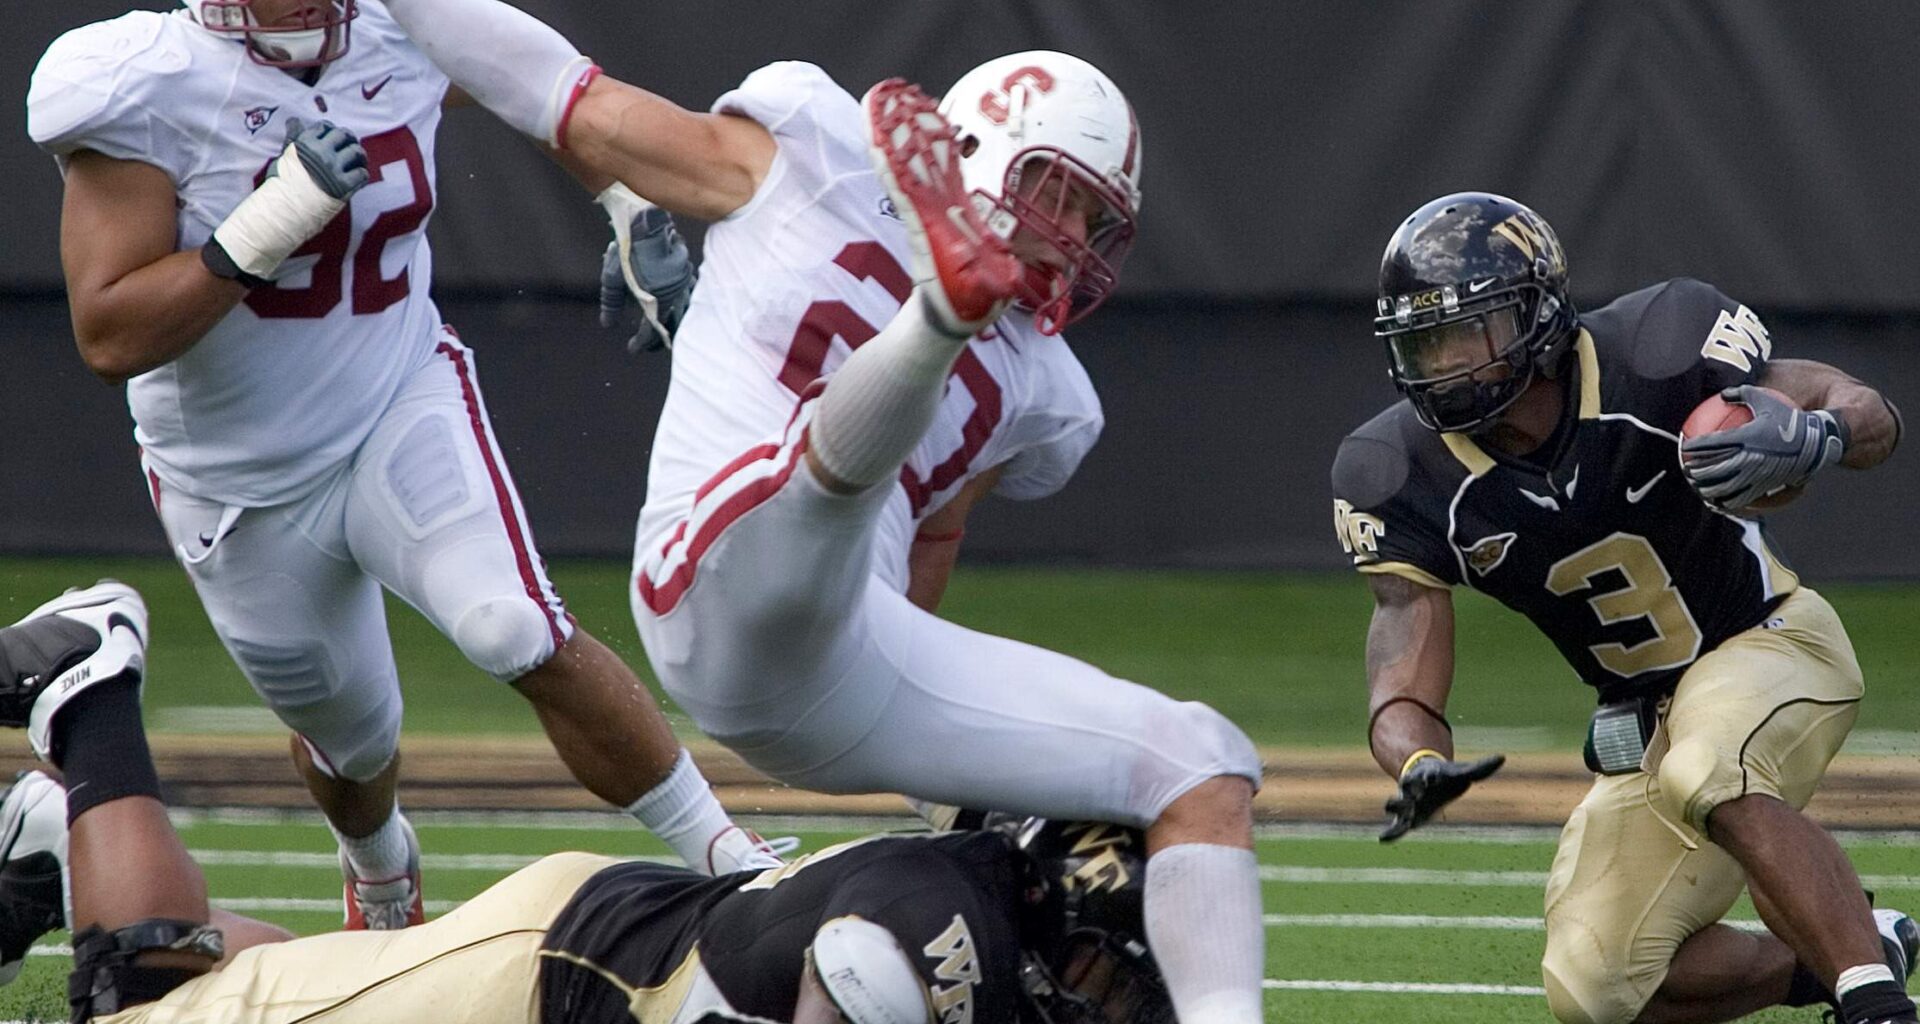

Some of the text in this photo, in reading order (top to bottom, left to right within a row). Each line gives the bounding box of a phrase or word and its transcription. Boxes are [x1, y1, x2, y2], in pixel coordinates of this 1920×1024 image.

[1412, 290, 1441, 309] ACC
[1701, 304, 1772, 373] WF
[1544, 531, 1703, 679] 3
[60, 665, 91, 695] NIKE
